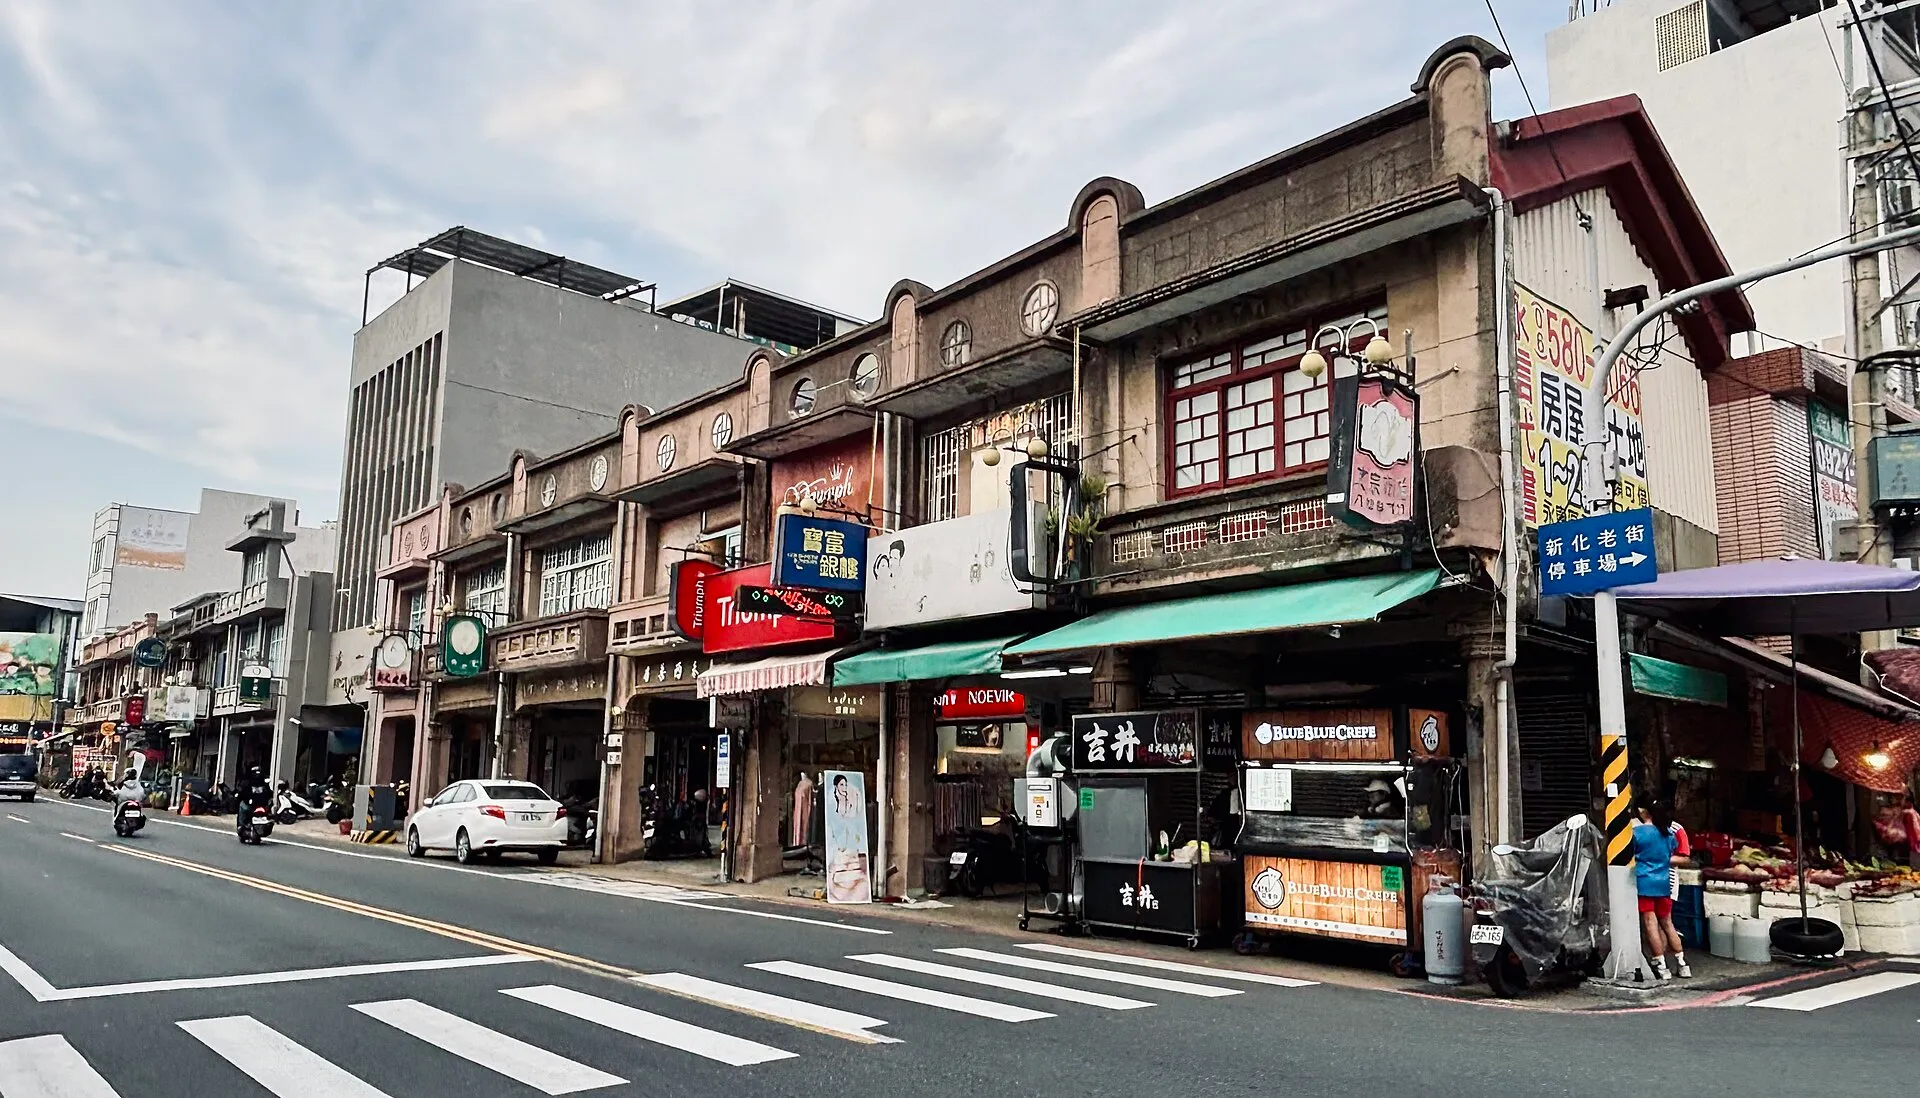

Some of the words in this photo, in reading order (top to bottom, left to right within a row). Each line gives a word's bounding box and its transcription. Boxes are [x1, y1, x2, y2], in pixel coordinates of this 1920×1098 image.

[1541, 371, 1584, 447] 房屋
[803, 527, 845, 555] 寶富
[1546, 524, 1645, 557] 新化老街
[819, 555, 859, 580] 銀樓
[1547, 553, 1617, 581] 停車場
[692, 580, 705, 629] Triumph
[1083, 720, 1141, 763] 吉井
[1119, 882, 1154, 910] 吉井
